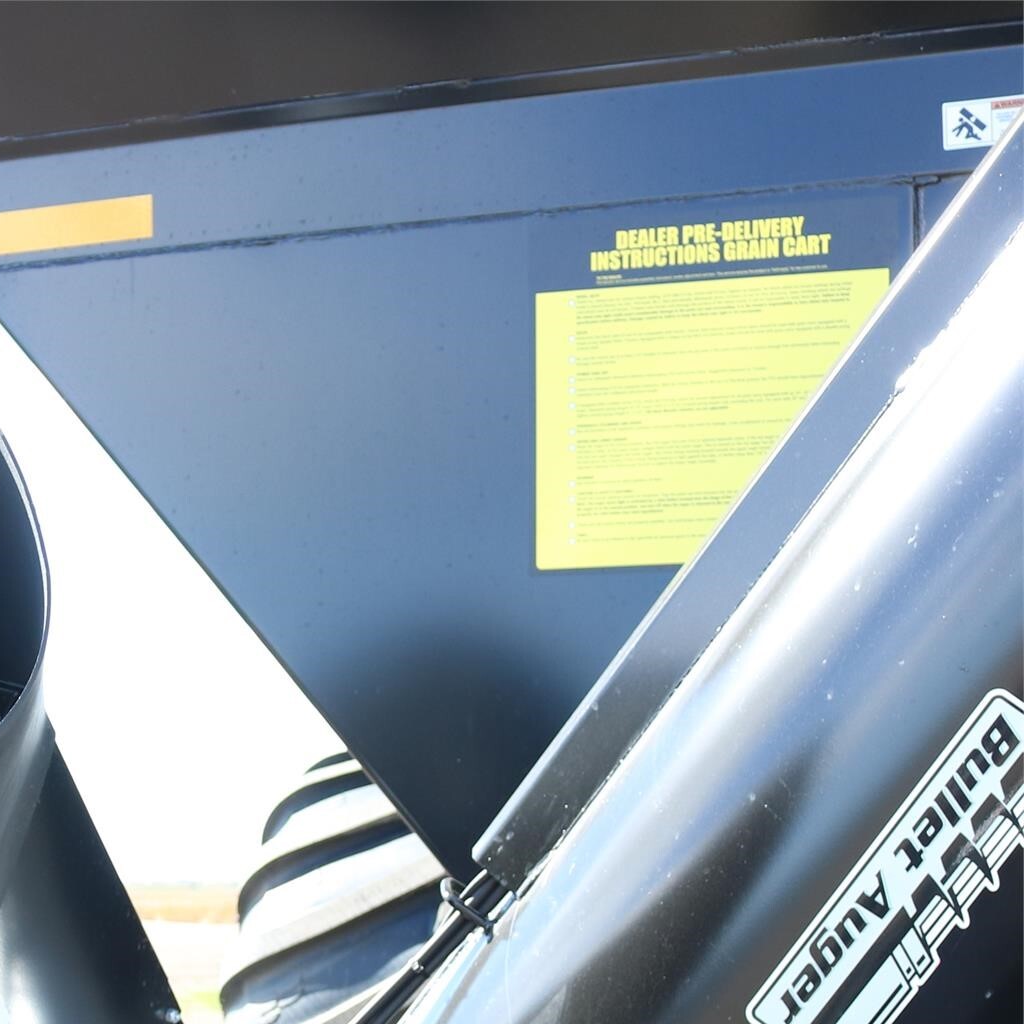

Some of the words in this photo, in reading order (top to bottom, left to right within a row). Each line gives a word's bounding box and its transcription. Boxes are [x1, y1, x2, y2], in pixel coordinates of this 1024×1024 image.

[615, 225, 679, 249] DEALER
[682, 216, 805, 244] PRE-DELIVERY
[590, 243, 721, 272] INSTRUCTIONS
[723, 238, 780, 262] GRAIN
[782, 234, 831, 257] CART
[893, 713, 1021, 872] Bullet
